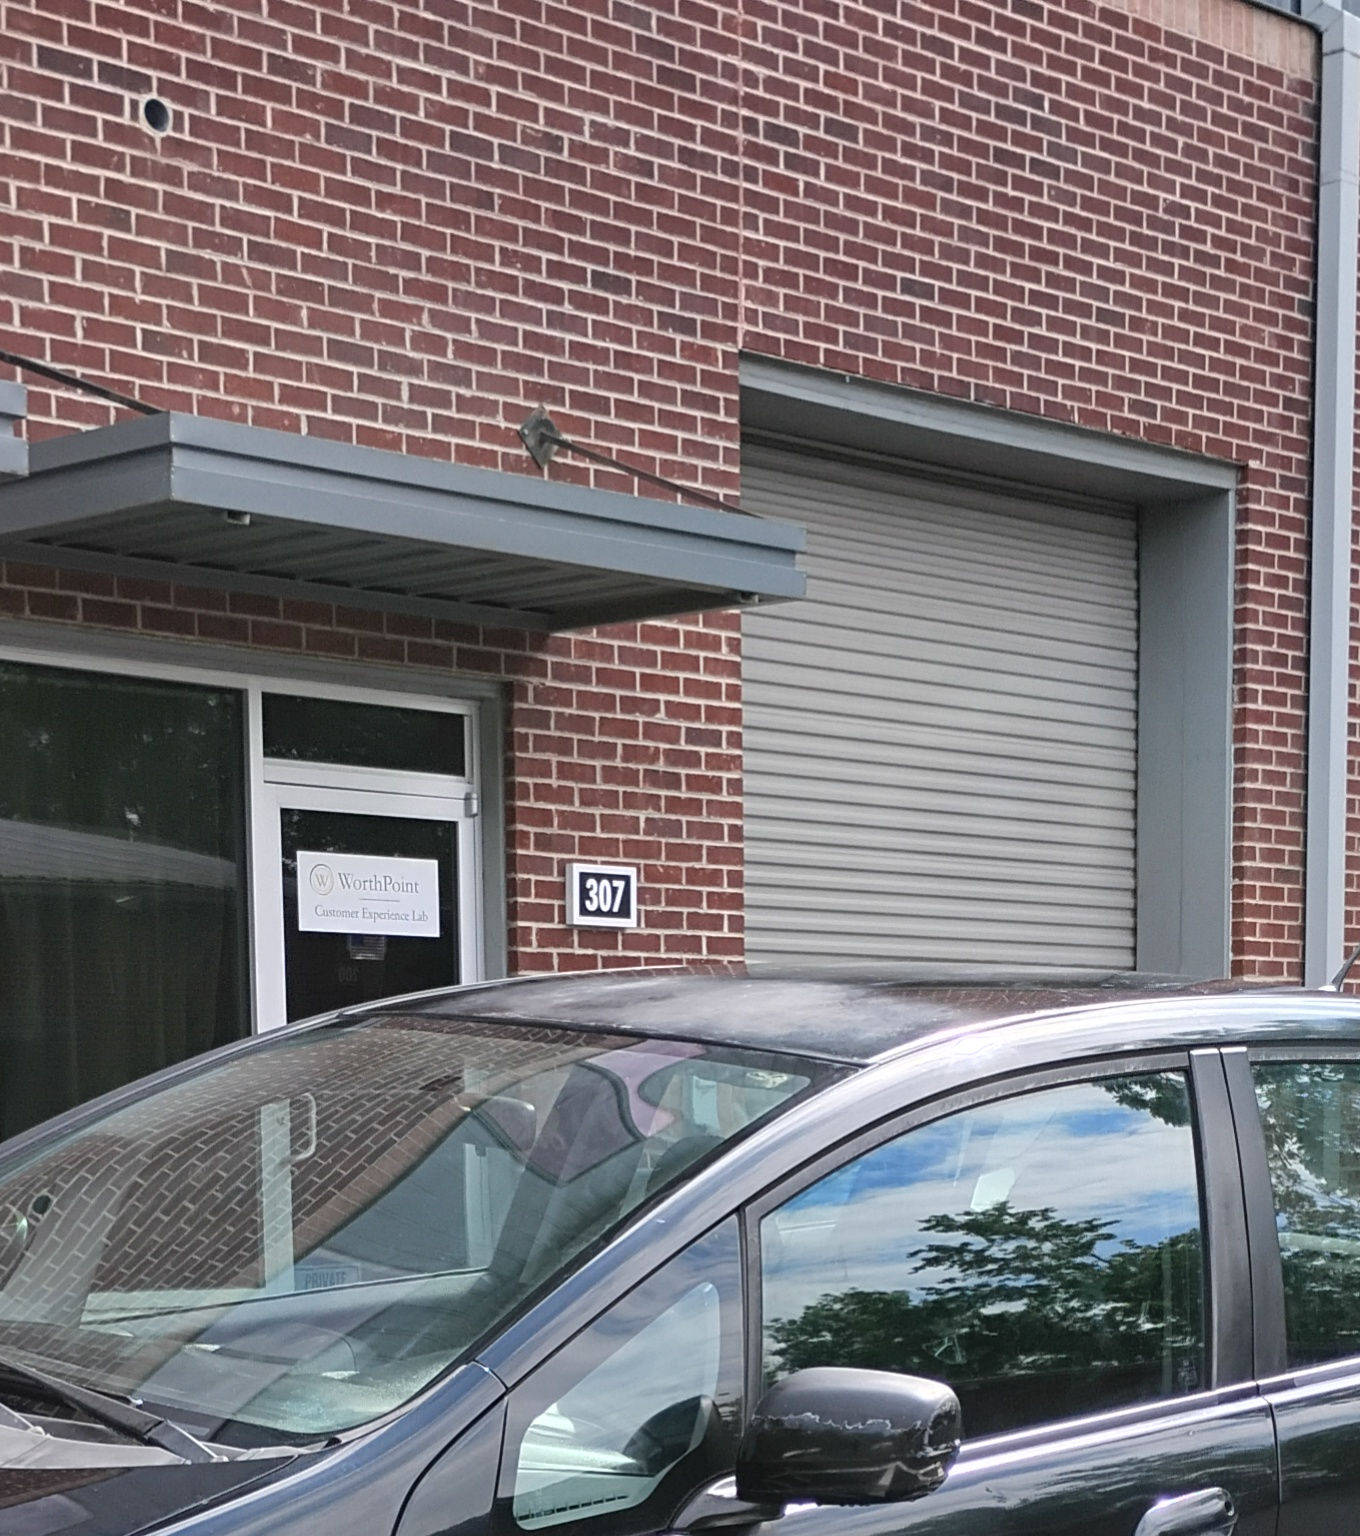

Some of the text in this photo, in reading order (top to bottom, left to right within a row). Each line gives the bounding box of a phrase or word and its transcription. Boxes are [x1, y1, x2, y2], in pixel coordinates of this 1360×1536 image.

[338, 872, 419, 894] WorthPoint
[584, 878, 625, 913] 307
[314, 905, 429, 923] Customer Experience Lab
